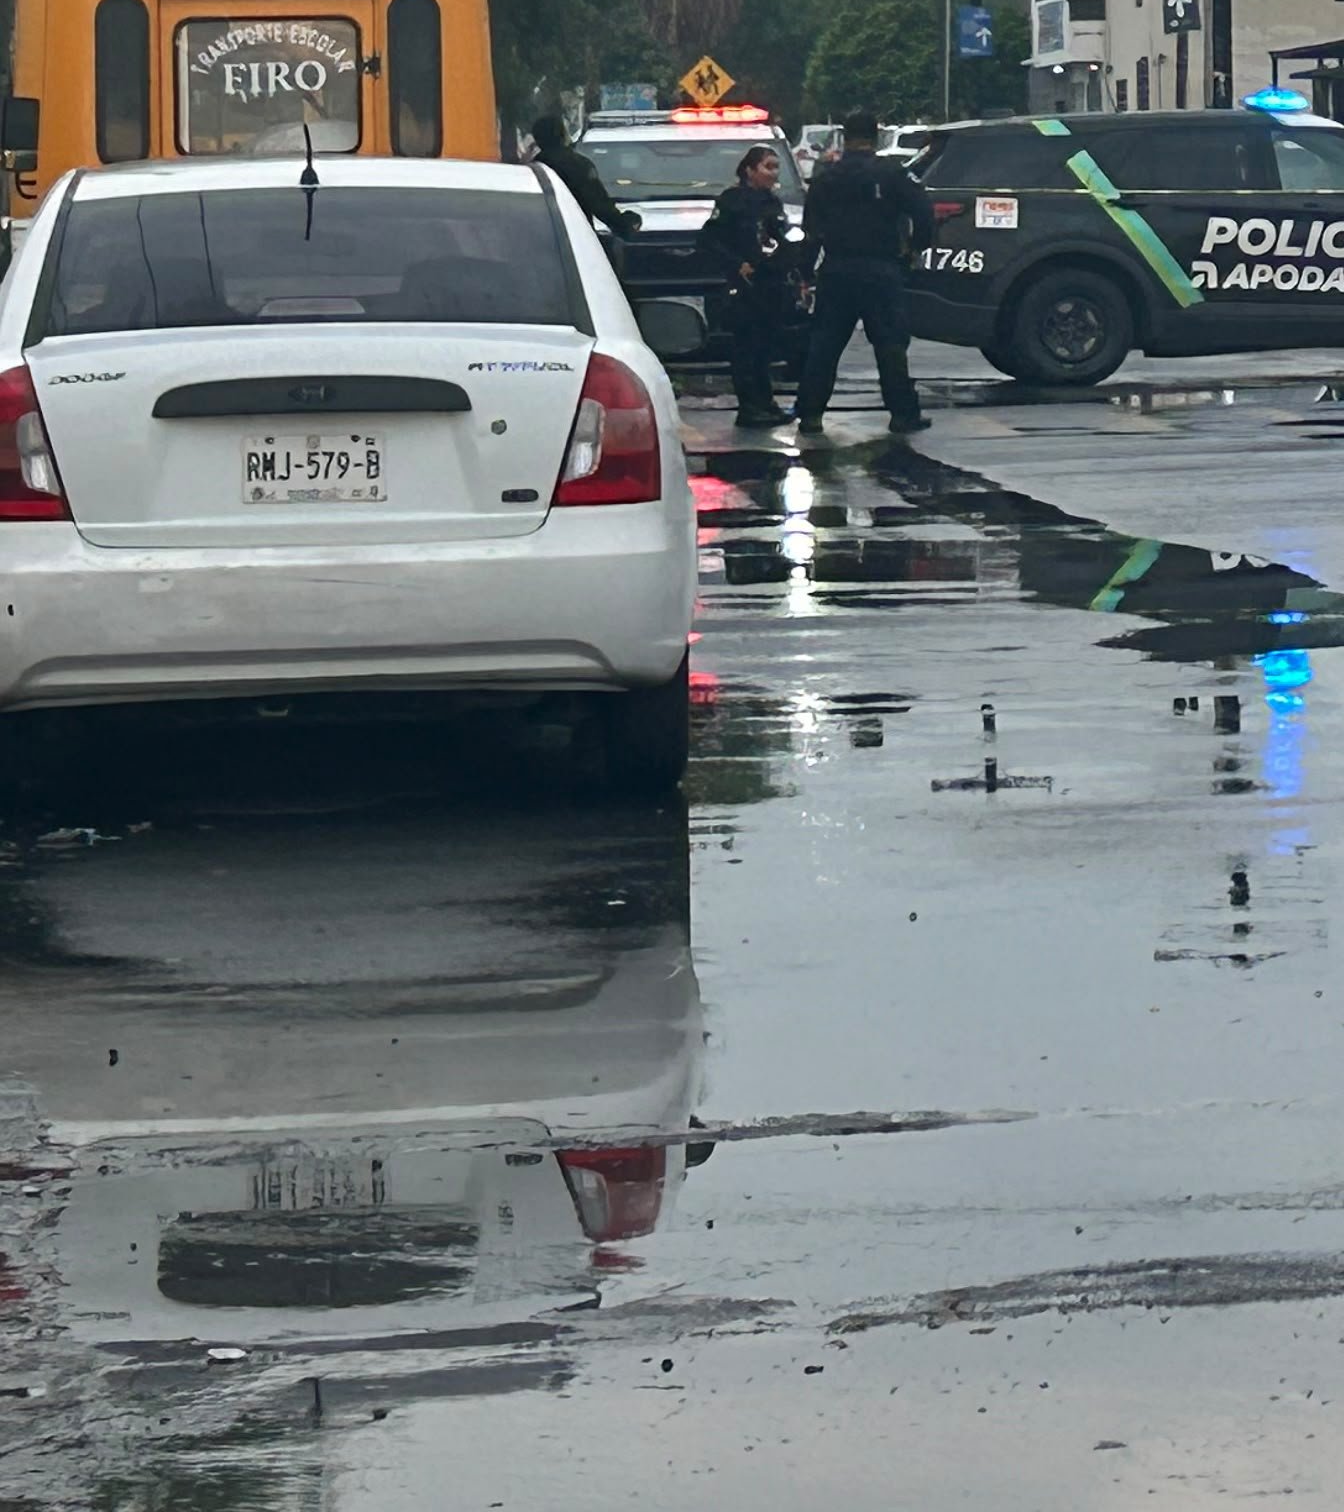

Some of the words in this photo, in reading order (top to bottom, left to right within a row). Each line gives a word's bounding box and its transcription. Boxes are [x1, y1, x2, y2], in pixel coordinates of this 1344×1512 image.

[190, 23, 284, 75] TRANSPORTE
[291, 24, 356, 73] ESCOLAR
[921, 247, 984, 273] 1746
